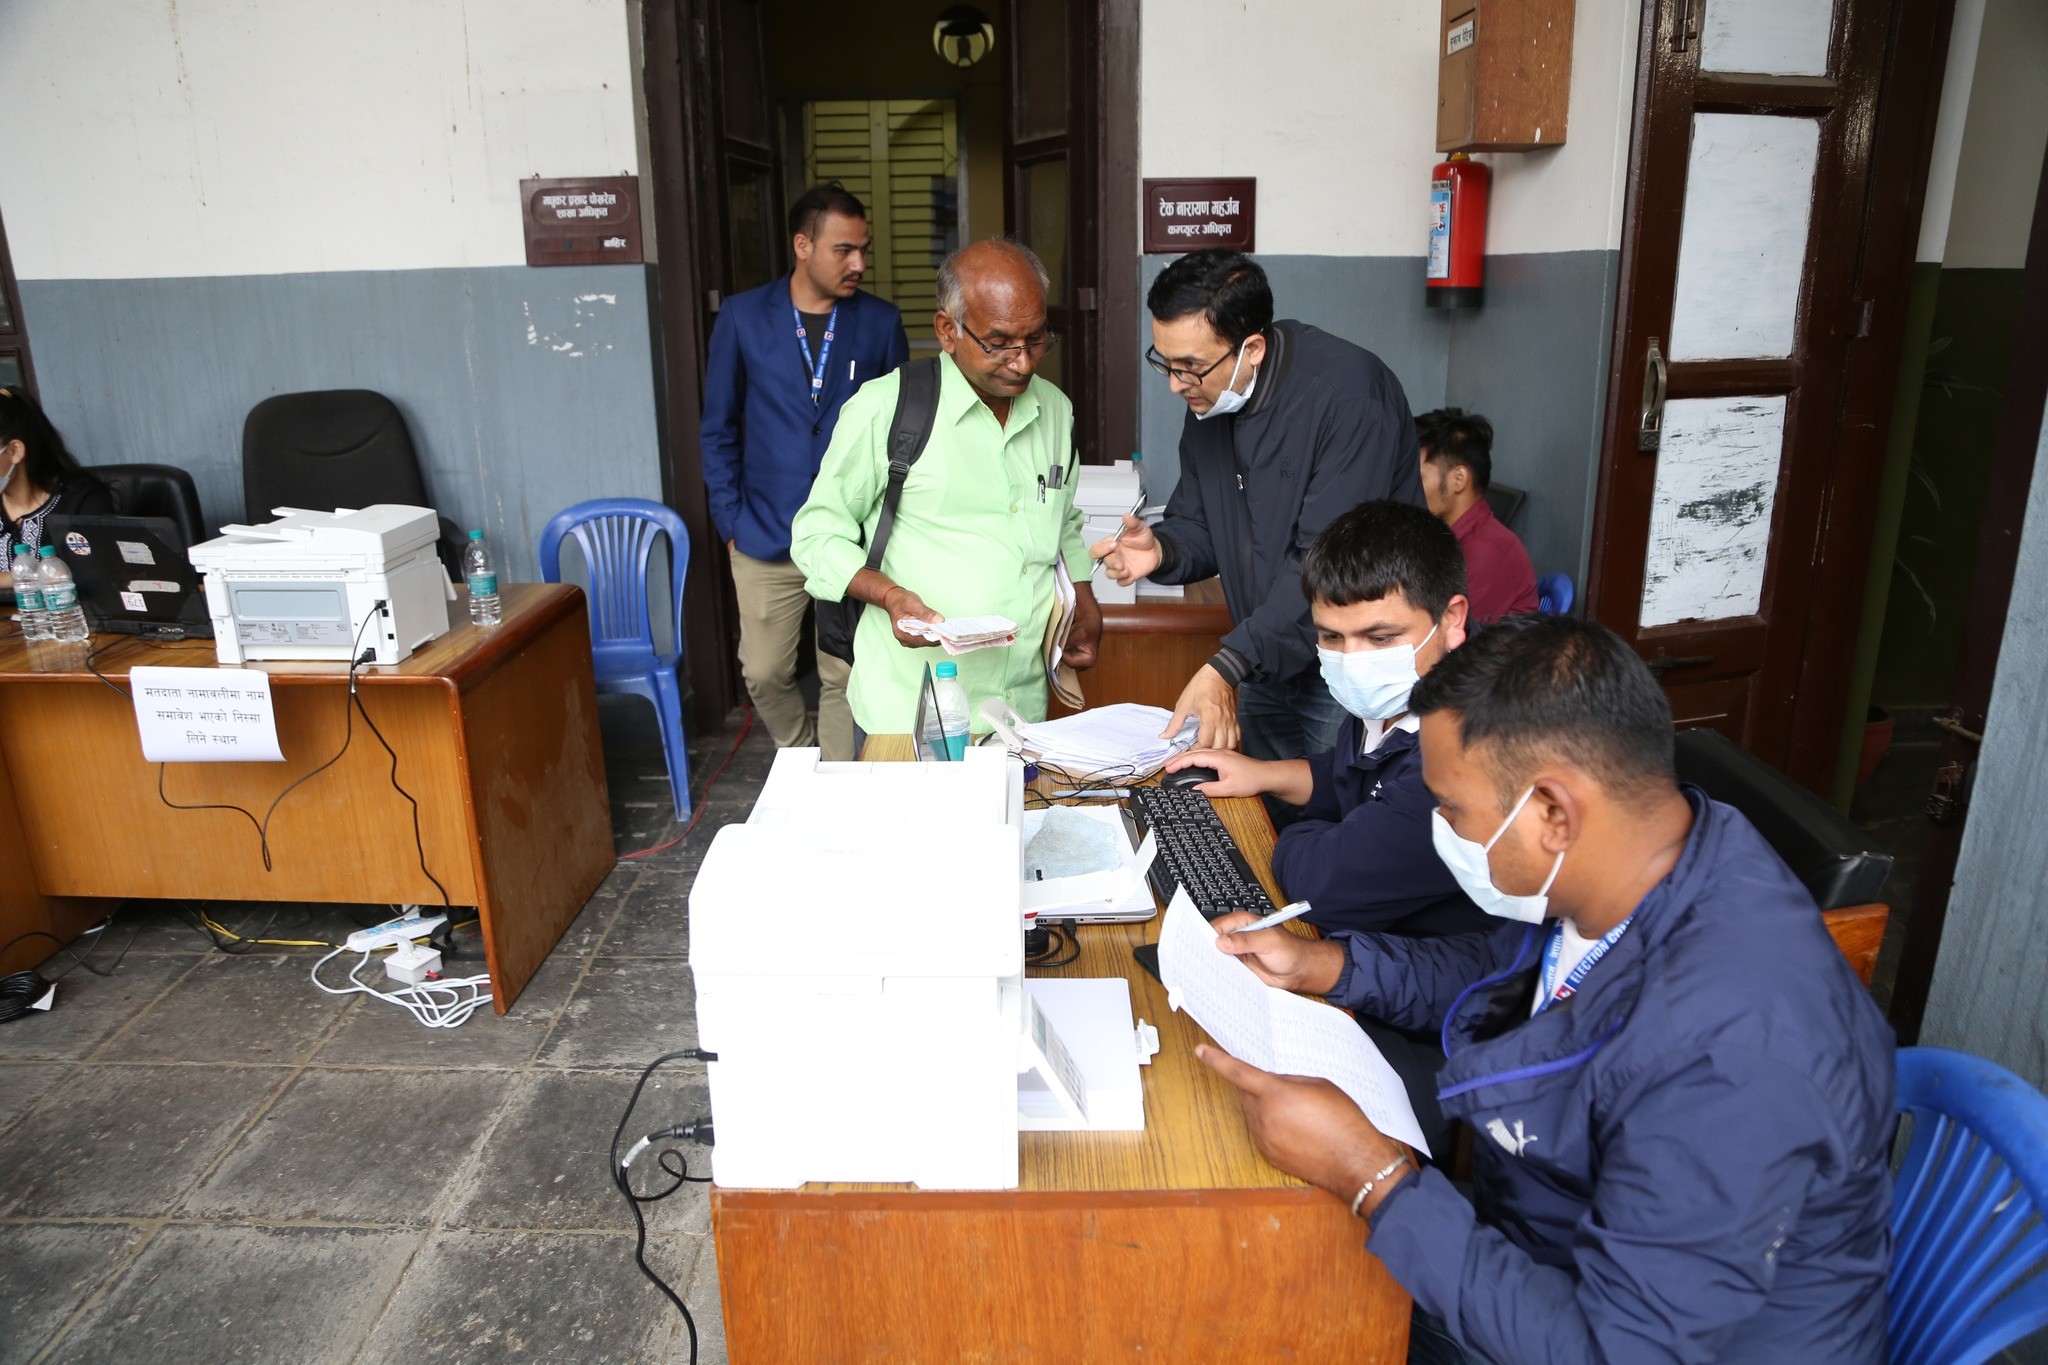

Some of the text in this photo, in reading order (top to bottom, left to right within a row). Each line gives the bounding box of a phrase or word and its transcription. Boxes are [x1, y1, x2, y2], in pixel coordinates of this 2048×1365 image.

[578, 205, 608, 219] अधिकृत
[1159, 196, 1240, 217] टेक नारायण महर्जन
[1202, 221, 1232, 236] अधिकृत
[144, 686, 266, 701] मतदाता नामावलीमा नाम
[156, 707, 261, 724] समावेश भएको निस्सा
[186, 730, 238, 745] लिने स्थान
[1569, 940, 1610, 984] ELECTION
